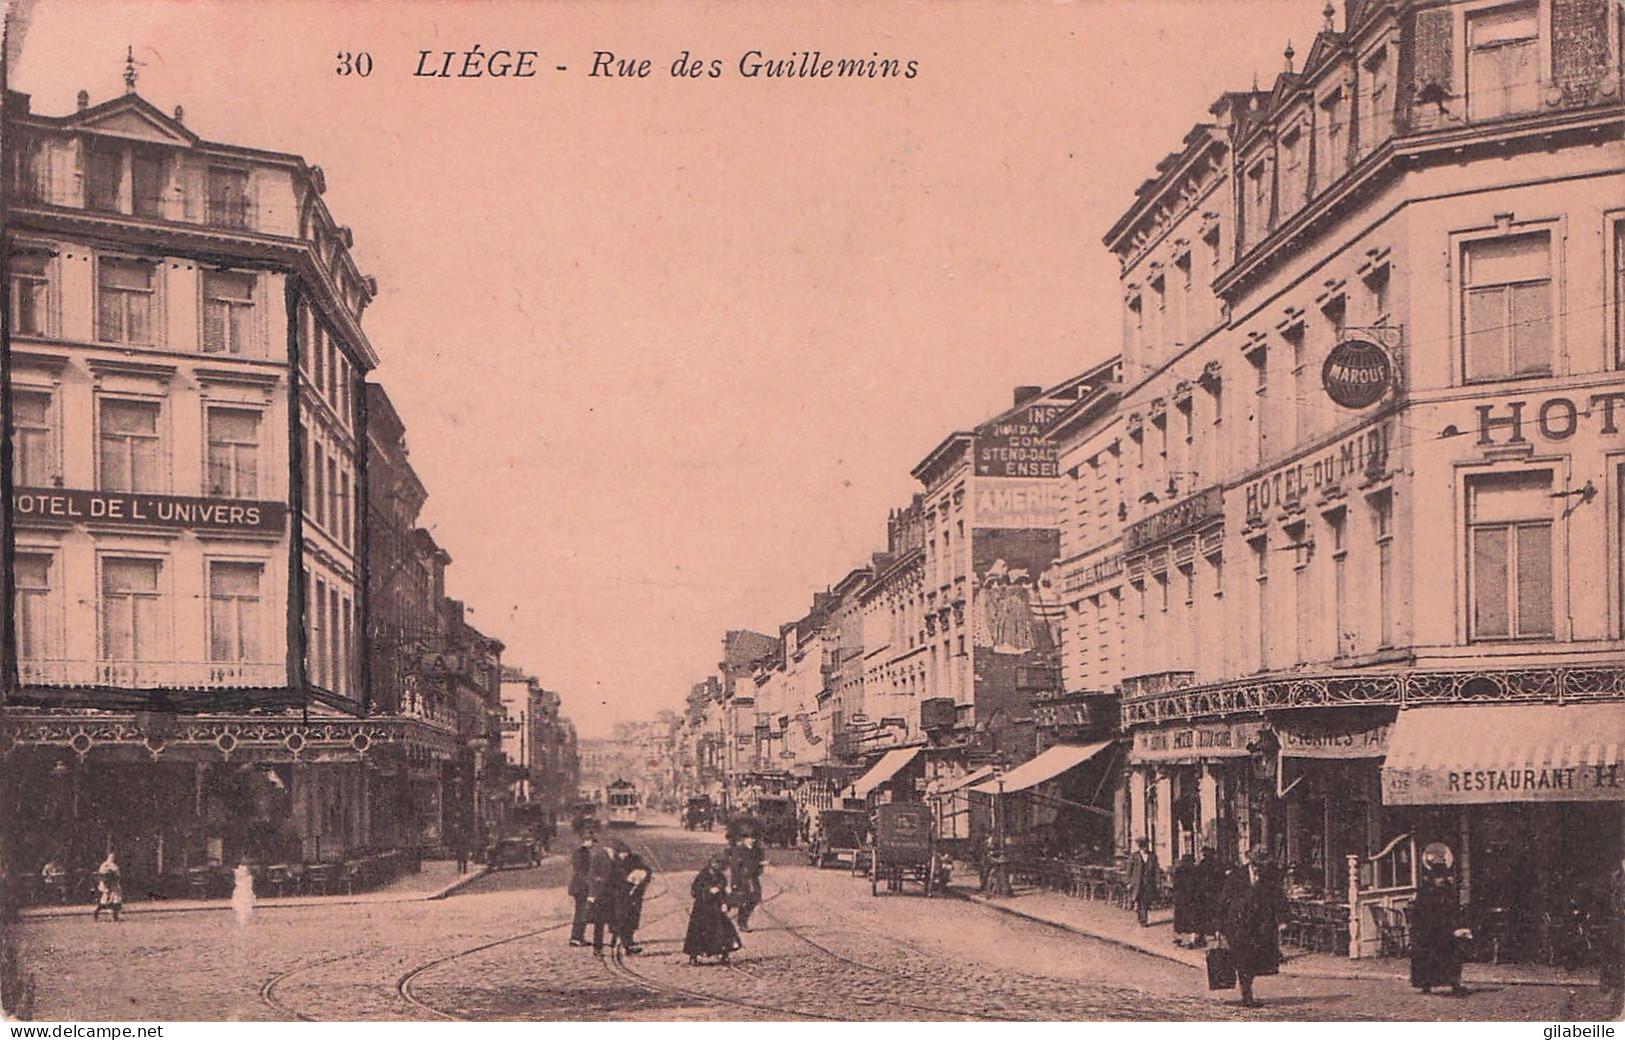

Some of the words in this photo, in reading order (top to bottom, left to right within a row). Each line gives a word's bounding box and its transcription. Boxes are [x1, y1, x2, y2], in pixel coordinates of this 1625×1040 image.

[1008, 436, 1057, 447] COM
[1245, 464, 1308, 517] HOTEL
[1313, 456, 1335, 488] DU
[12, 495, 82, 515] OTEL
[90, 498, 124, 518] DE
[132, 501, 261, 525] L'UNIVERS
[1448, 767, 1577, 792] RESTAURANT
